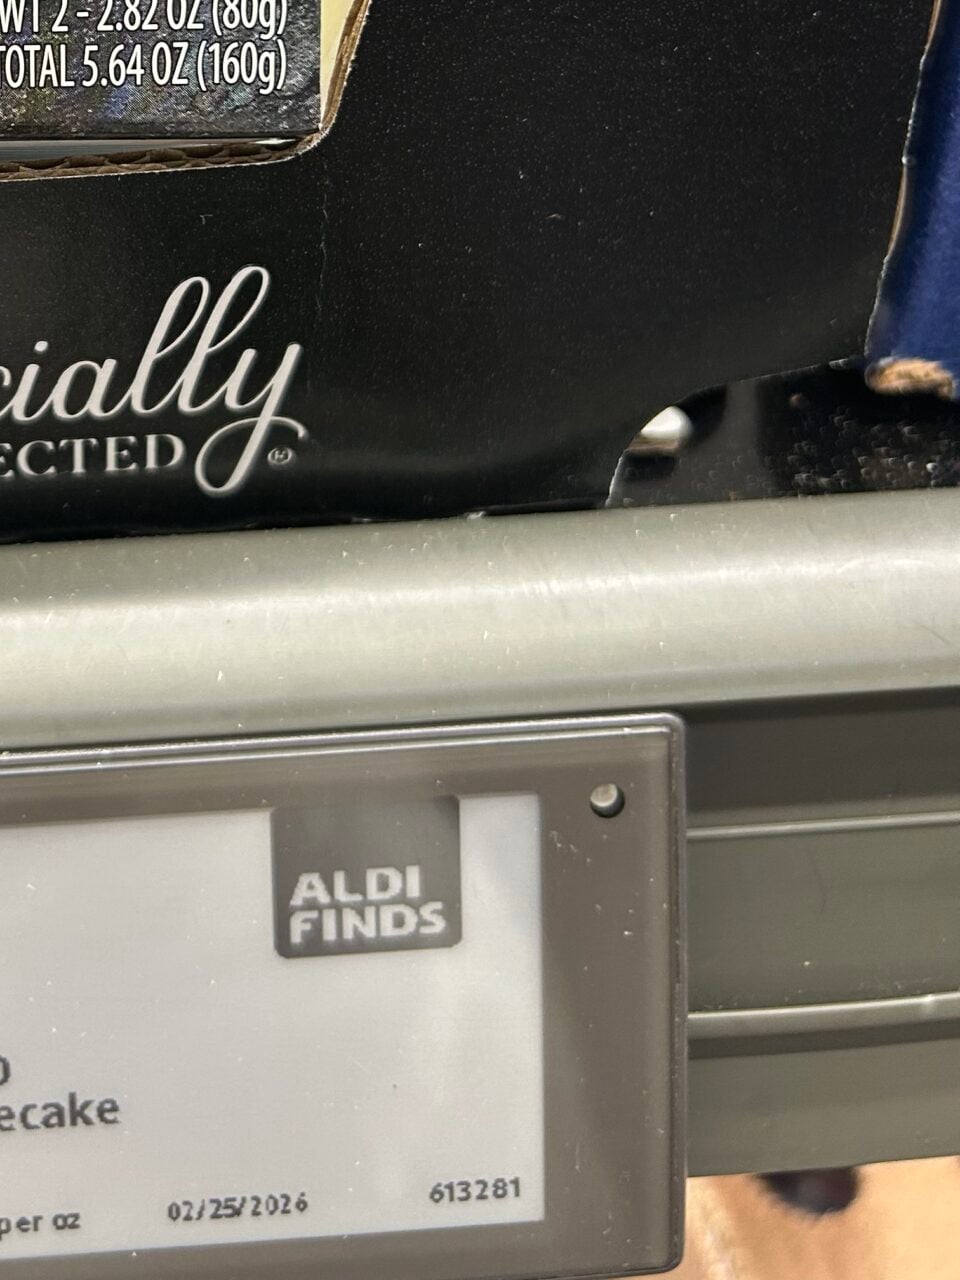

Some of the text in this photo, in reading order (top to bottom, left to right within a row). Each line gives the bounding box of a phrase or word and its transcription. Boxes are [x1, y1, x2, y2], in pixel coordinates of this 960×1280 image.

[82, 43, 145, 88] 5.64
[151, 41, 190, 86] OZ
[197, 39, 287, 95] (160g)
[289, 865, 422, 906] ALDI
[289, 901, 447, 945] FINDS
[167, 1192, 309, 1222] 02/25/2026
[429, 1177, 521, 1204] 613281
[52, 1212, 81, 1231] oz
